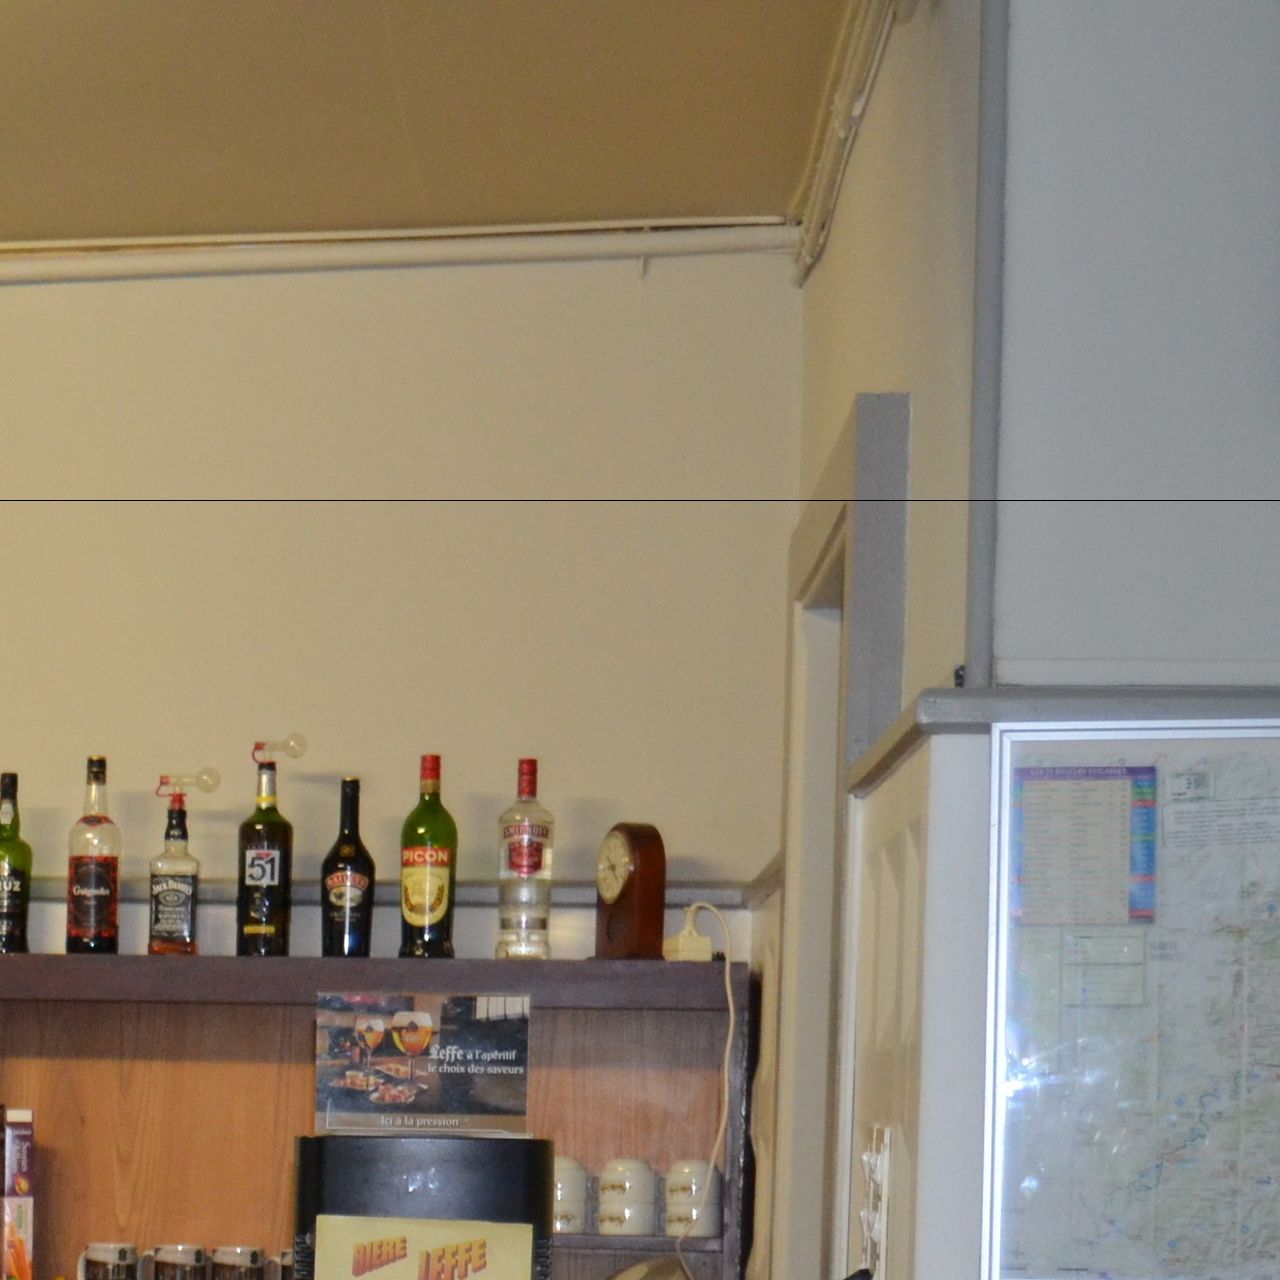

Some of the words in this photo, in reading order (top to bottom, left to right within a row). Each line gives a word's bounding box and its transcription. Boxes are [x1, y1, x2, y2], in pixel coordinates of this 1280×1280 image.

[402, 850, 448, 863] PICON
[248, 857, 276, 882] 51
[439, 1063, 466, 1073] choix
[467, 1064, 485, 1074] des
